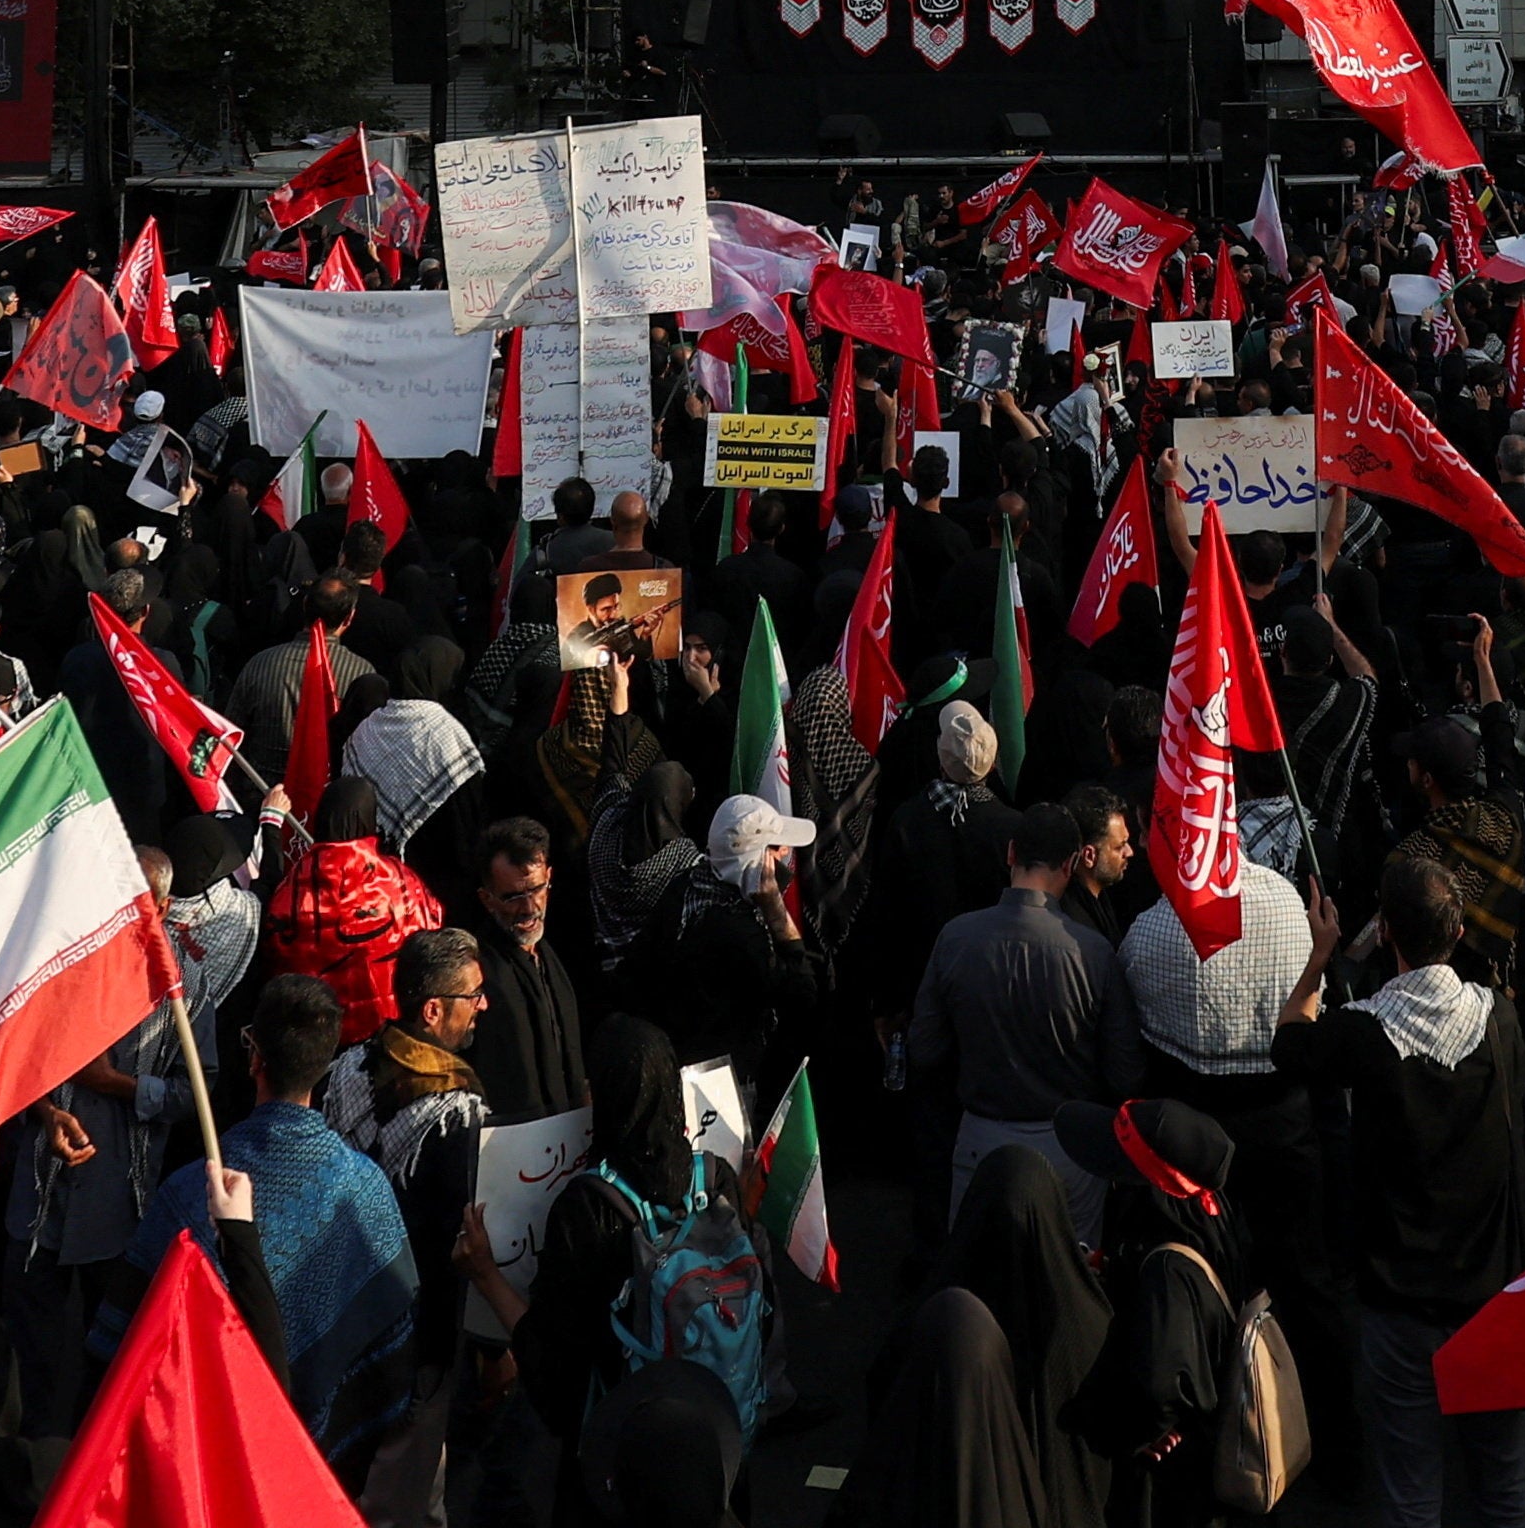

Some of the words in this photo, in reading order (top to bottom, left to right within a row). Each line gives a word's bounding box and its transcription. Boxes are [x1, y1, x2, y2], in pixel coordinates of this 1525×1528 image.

[1180, 325, 1216, 345] ایران
[722, 420, 765, 438] اسرائیل
[769, 426, 781, 439] بر
[785, 422, 814, 440] مرگ
[718, 446, 749, 456] DOWN
[751, 448, 776, 457] WITH
[778, 449, 814, 459] ISRAEL
[773, 466, 812, 484] الموت
[1184, 453, 1328, 509] خداحافظ
